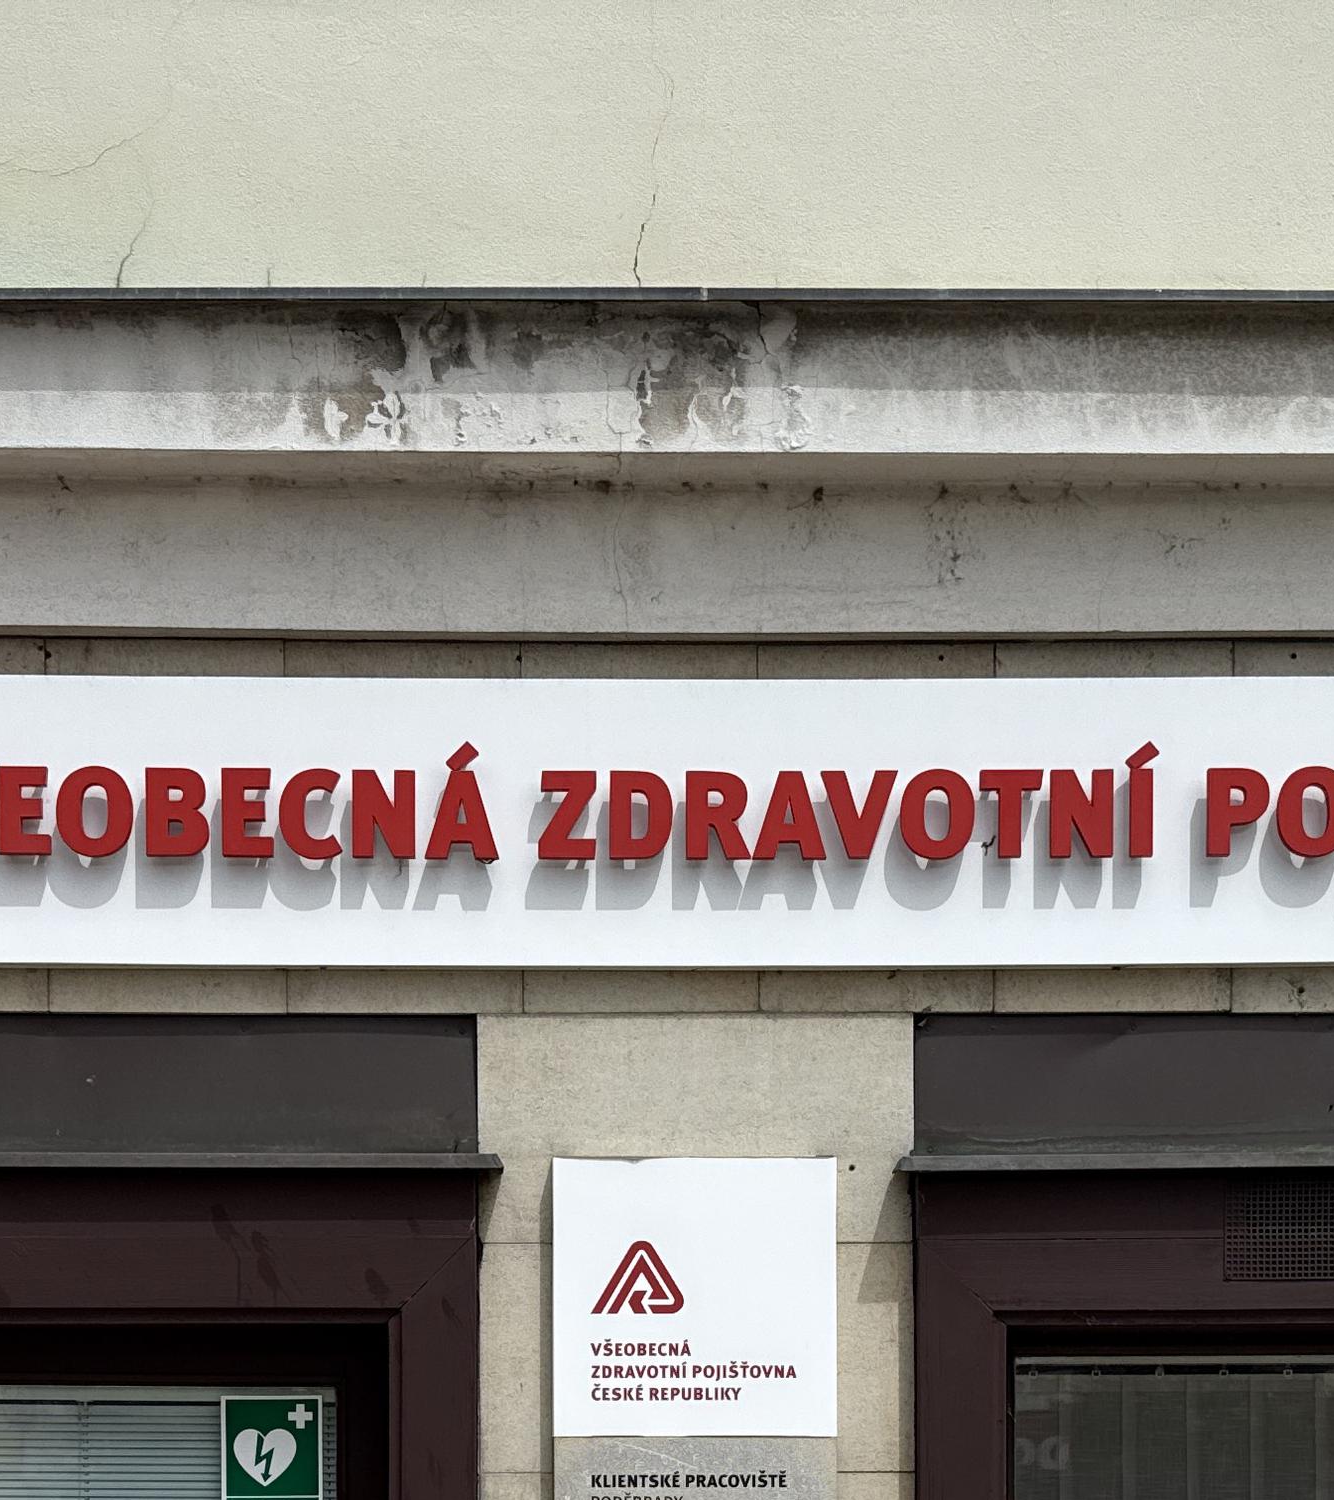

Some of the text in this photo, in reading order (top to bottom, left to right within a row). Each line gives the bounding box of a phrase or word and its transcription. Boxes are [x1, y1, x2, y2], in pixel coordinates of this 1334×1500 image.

[539, 743, 1157, 859] ZDRAVOTNÍ
[591, 1339, 691, 1356] VŠEOBECNÁ
[592, 1361, 796, 1381] ZDRAVOTNÍ POJIŠŤOVNA
[592, 1384, 741, 1401] ČESKÉ REPUBLIKY
[591, 1470, 788, 1488] KLIENTSKÉ PRACOVIŠTĚ
